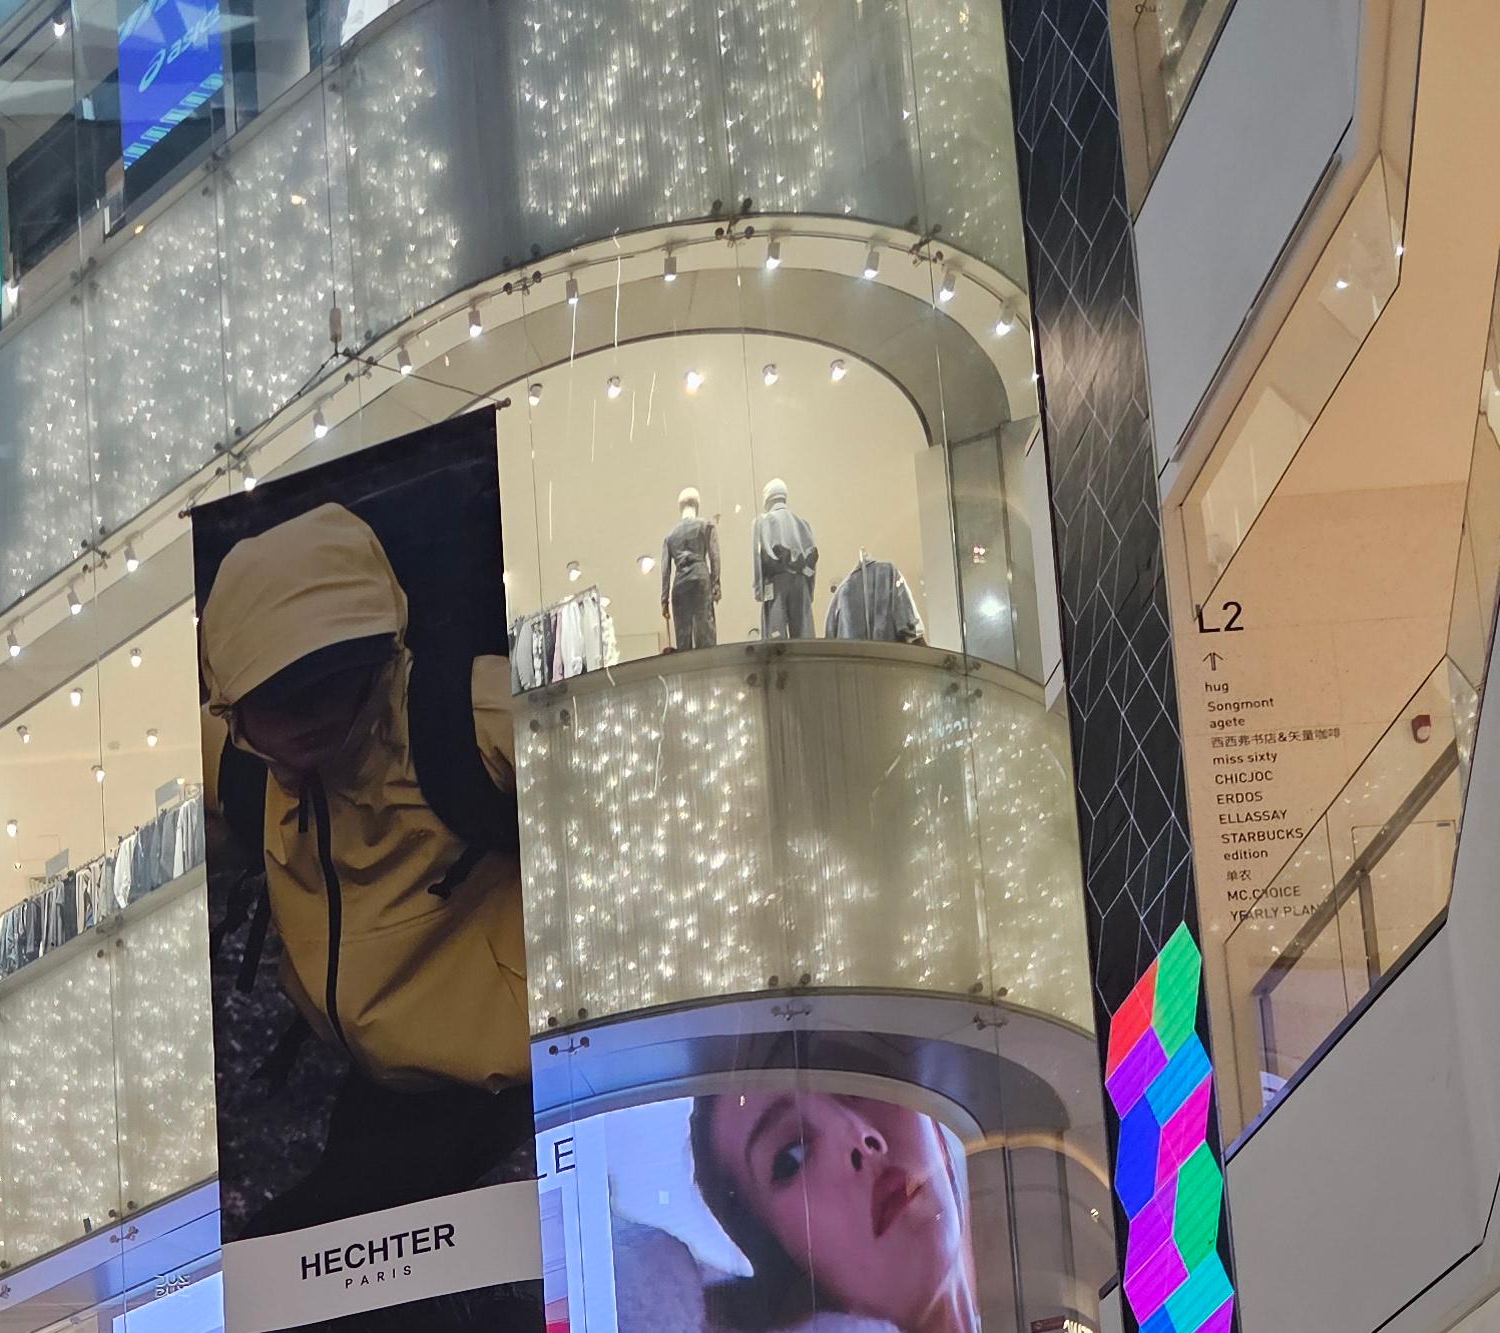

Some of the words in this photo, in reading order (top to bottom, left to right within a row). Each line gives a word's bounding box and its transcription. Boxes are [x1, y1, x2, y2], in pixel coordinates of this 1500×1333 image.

[1195, 601, 1244, 633] L2
[1205, 682, 1229, 693] hug
[1207, 698, 1274, 712] Songmont
[1209, 718, 1245, 731] agete
[1213, 753, 1244, 765] miss
[1247, 752, 1278, 764] sixty
[1215, 770, 1273, 784] CHICJOC
[1216, 791, 1263, 805] ERDOS
[1219, 809, 1287, 824] ELLASSAY
[1221, 828, 1304, 844] STARBUCKS
[1223, 849, 1268, 861] edition
[301, 1223, 456, 1280] HECHTER
[345, 1265, 412, 1289] PARIS
